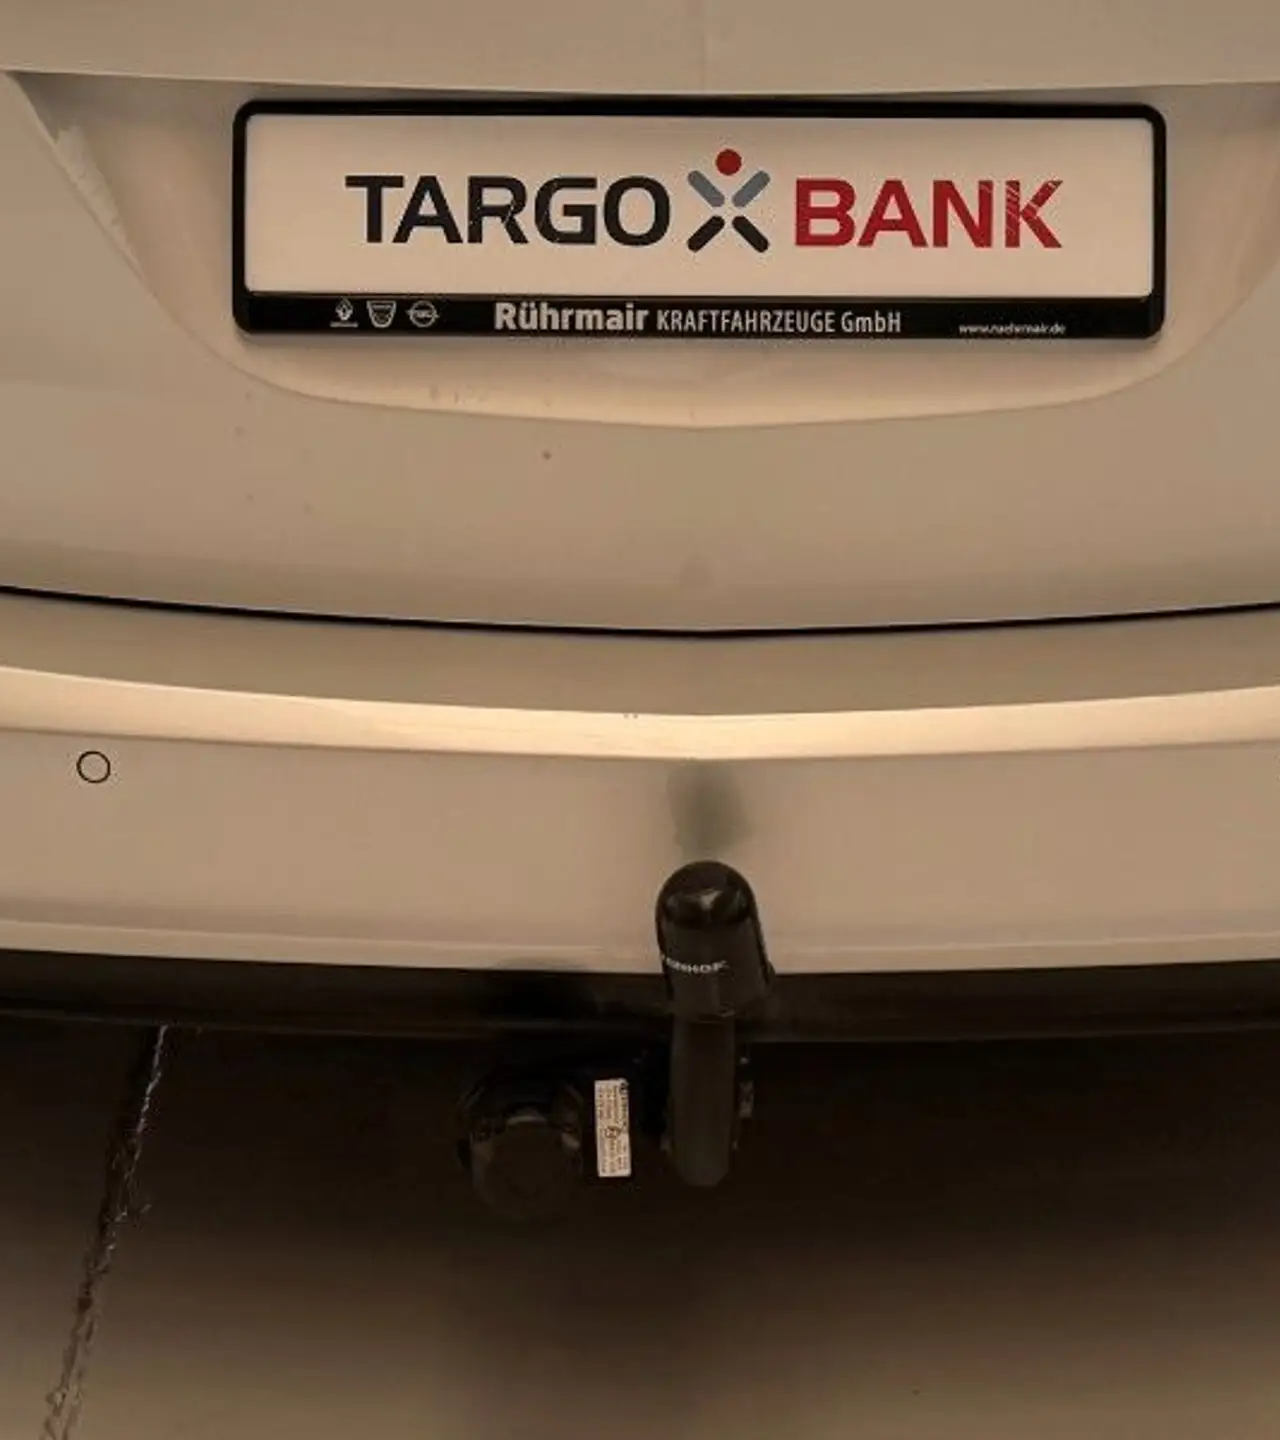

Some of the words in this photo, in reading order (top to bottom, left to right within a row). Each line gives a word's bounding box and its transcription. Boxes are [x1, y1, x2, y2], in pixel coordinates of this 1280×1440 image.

[345, 174, 671, 248] TARGO
[794, 178, 1064, 250] BANK
[494, 301, 650, 331] Rührmair
[656, 308, 836, 333] KRAFTFAHRZEUGE
[840, 310, 902, 333] GmbH
